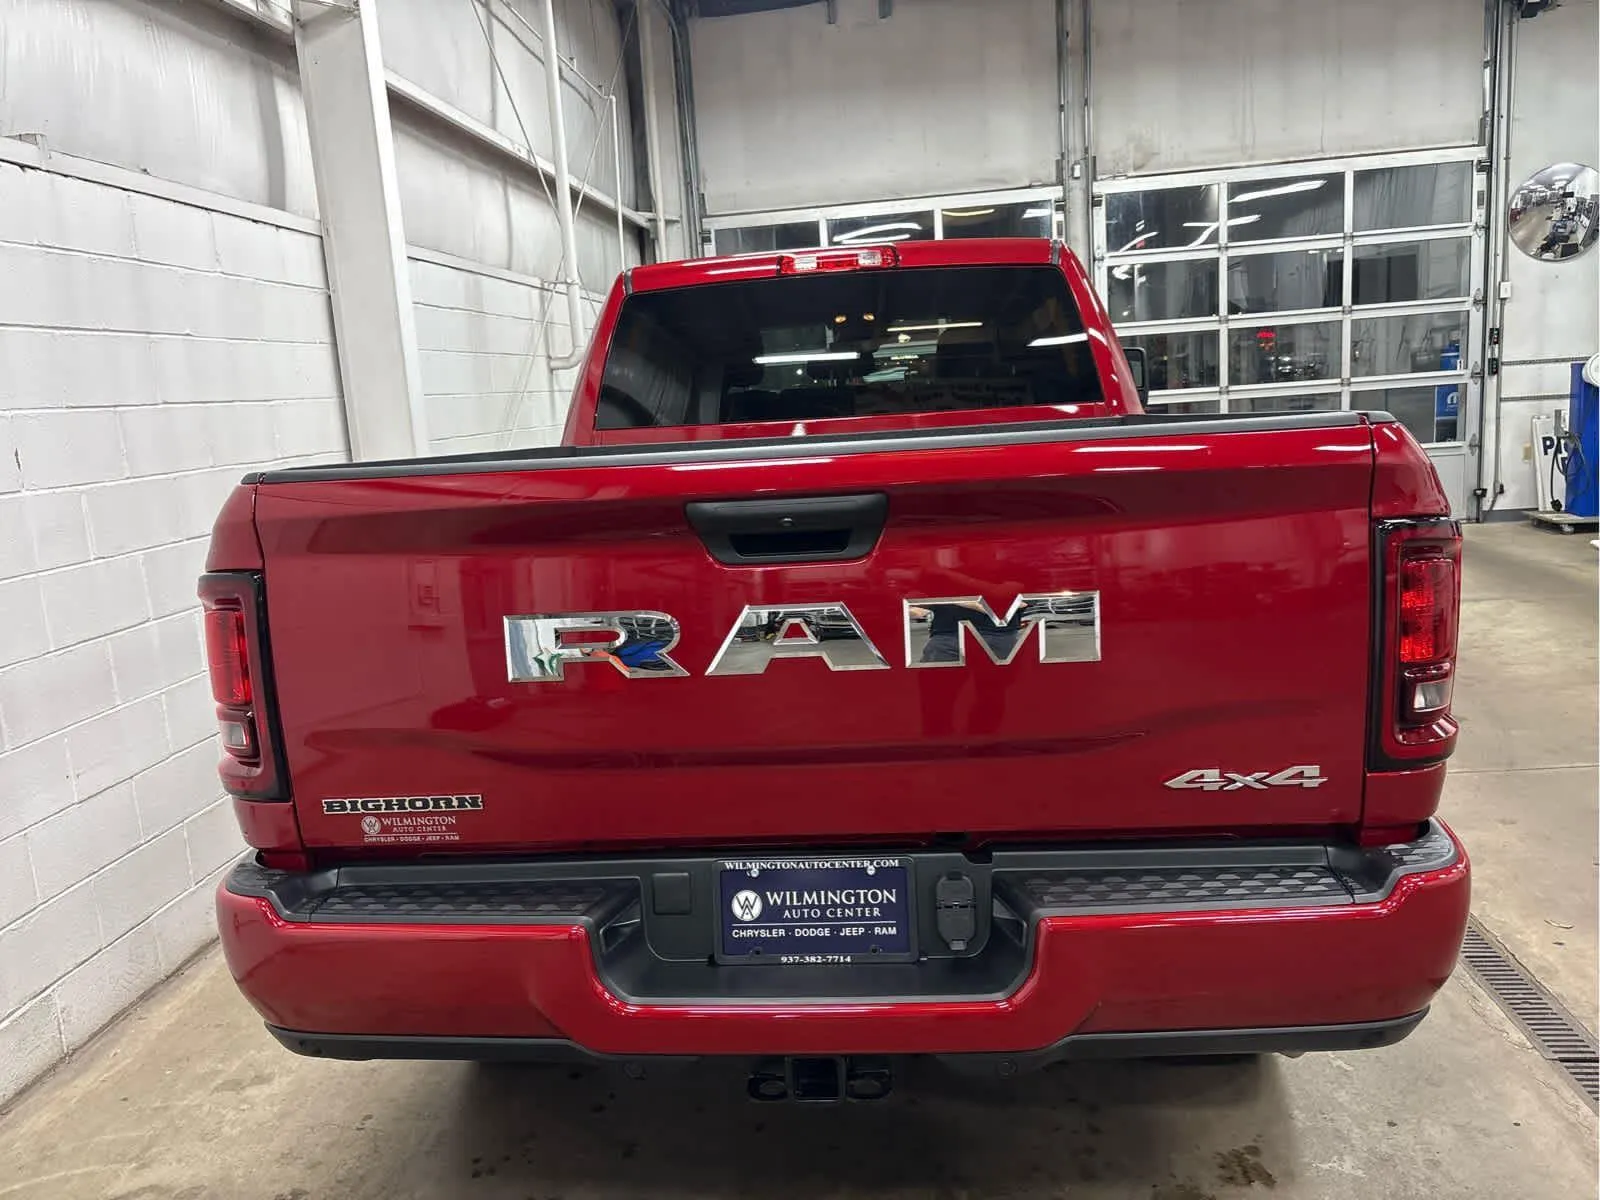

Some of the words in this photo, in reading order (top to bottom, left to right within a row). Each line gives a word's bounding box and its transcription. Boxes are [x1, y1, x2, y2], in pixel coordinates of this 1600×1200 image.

[503, 590, 1101, 682] RAM
[1164, 765, 1328, 791] 4x4
[322, 795, 483, 814] BIGHORN
[381, 815, 457, 825] WILMINGTON
[724, 859, 899, 870] WILMINGTONAUTOCENTER.COM
[766, 888, 897, 906] WILMINGTON
[783, 908, 821, 919] AUTO
[826, 907, 881, 918] CENTER
[732, 928, 786, 938] CHRYSLER
[794, 927, 831, 937] DODGE
[839, 927, 865, 936] JEEP
[874, 926, 897, 936] RAM
[780, 955, 851, 964] 937-382-7714
